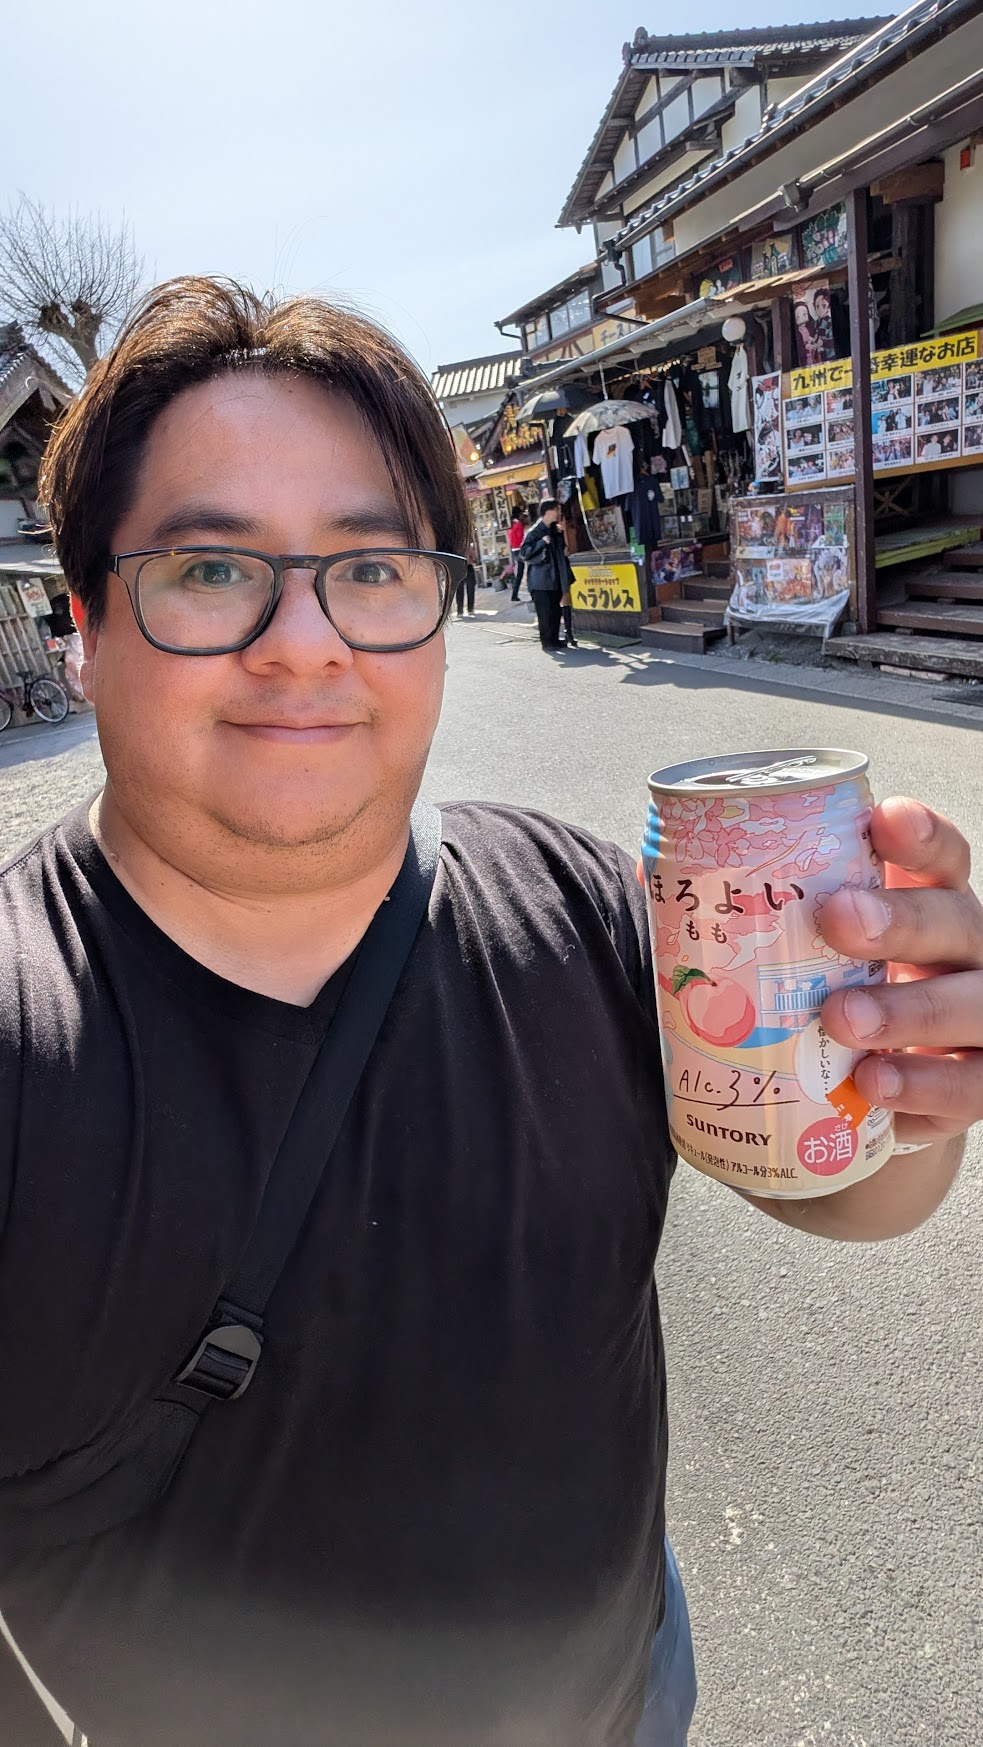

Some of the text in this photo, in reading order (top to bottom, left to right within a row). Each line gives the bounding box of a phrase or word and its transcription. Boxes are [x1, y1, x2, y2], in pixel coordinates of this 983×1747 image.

[577, 587, 635, 609] ヘラクレス
[650, 874, 805, 914] ほろよい
[686, 920, 728, 944] もも
[686, 1114, 773, 1147] SUNTORY
[834, 1122, 849, 1132] さけ
[803, 1130, 853, 1164] お酒
